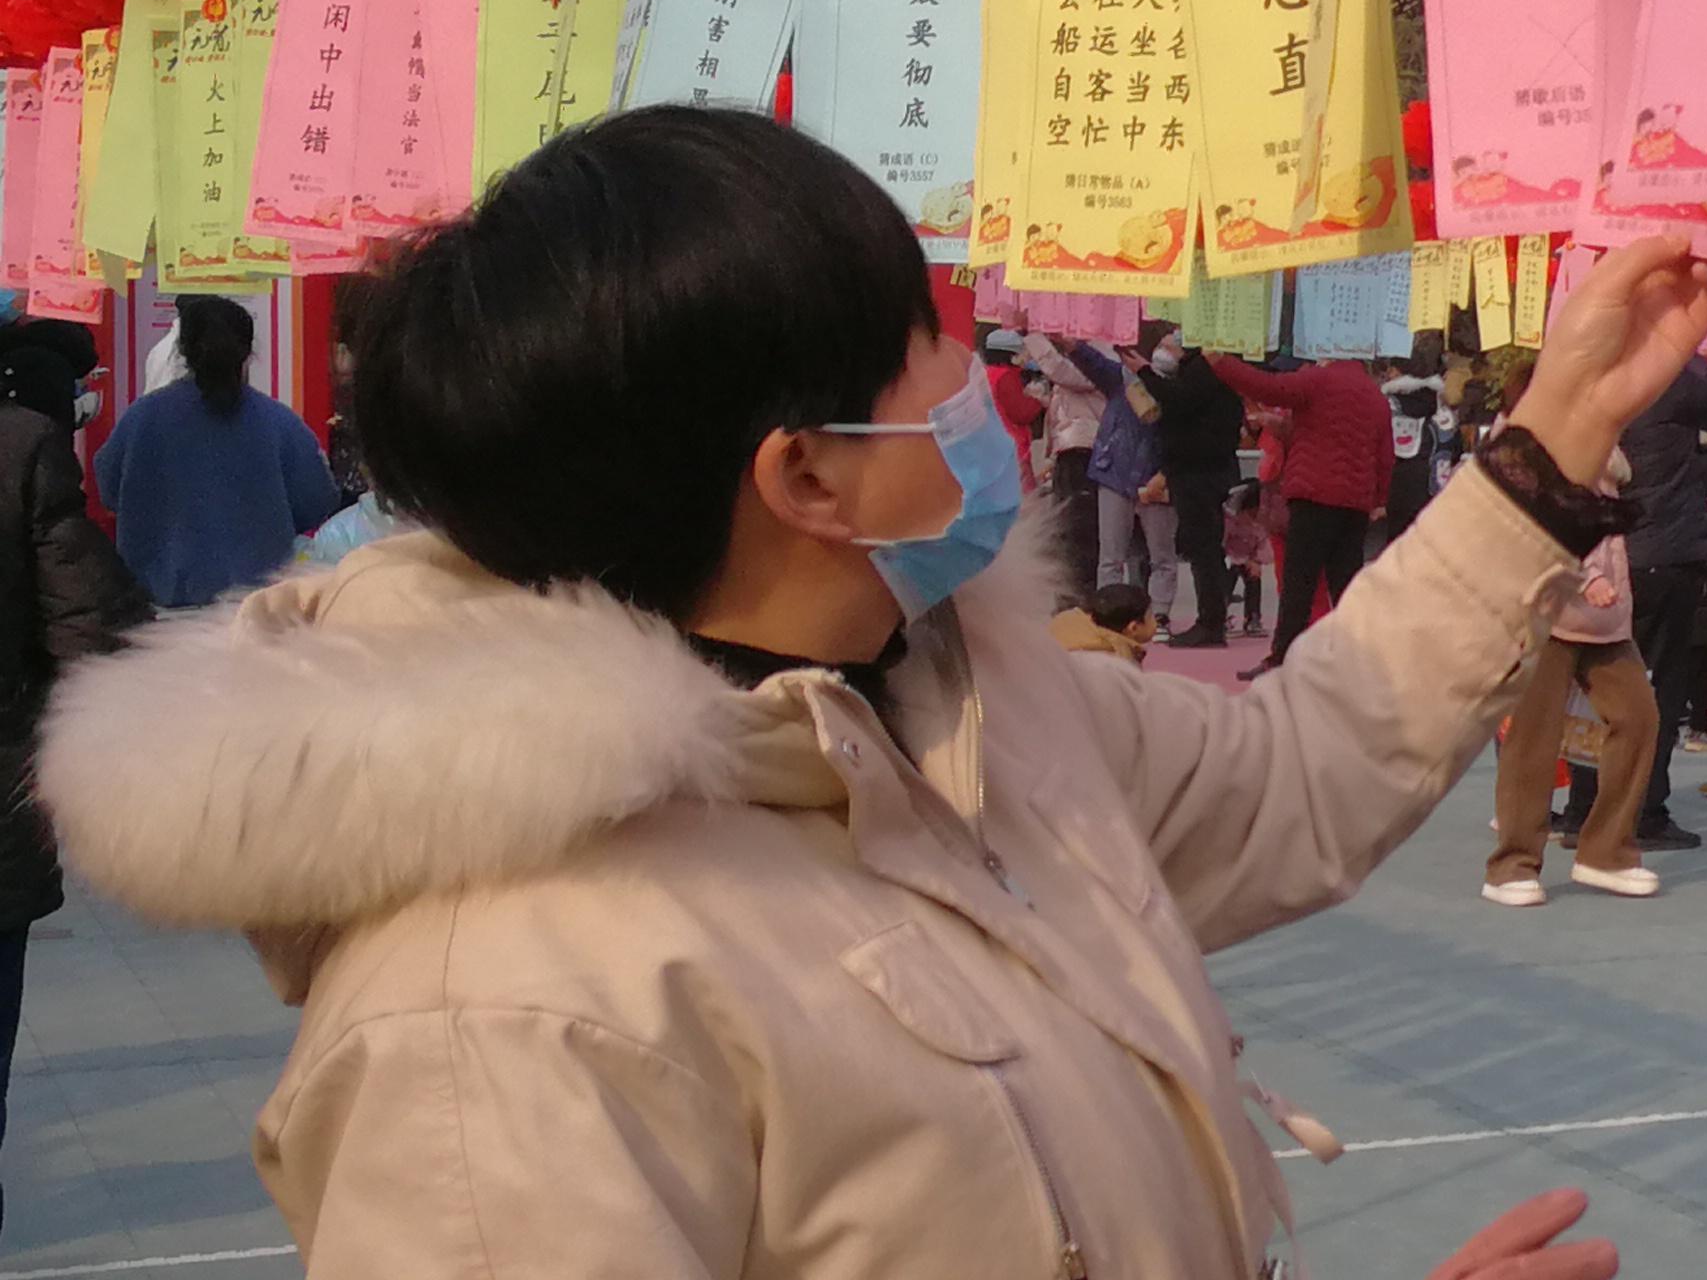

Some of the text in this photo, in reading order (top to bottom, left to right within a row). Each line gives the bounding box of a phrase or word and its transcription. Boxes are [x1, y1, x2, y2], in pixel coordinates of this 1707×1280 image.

[202, 73, 226, 204] 火上加油
[300, 2, 351, 156] 闲中出错
